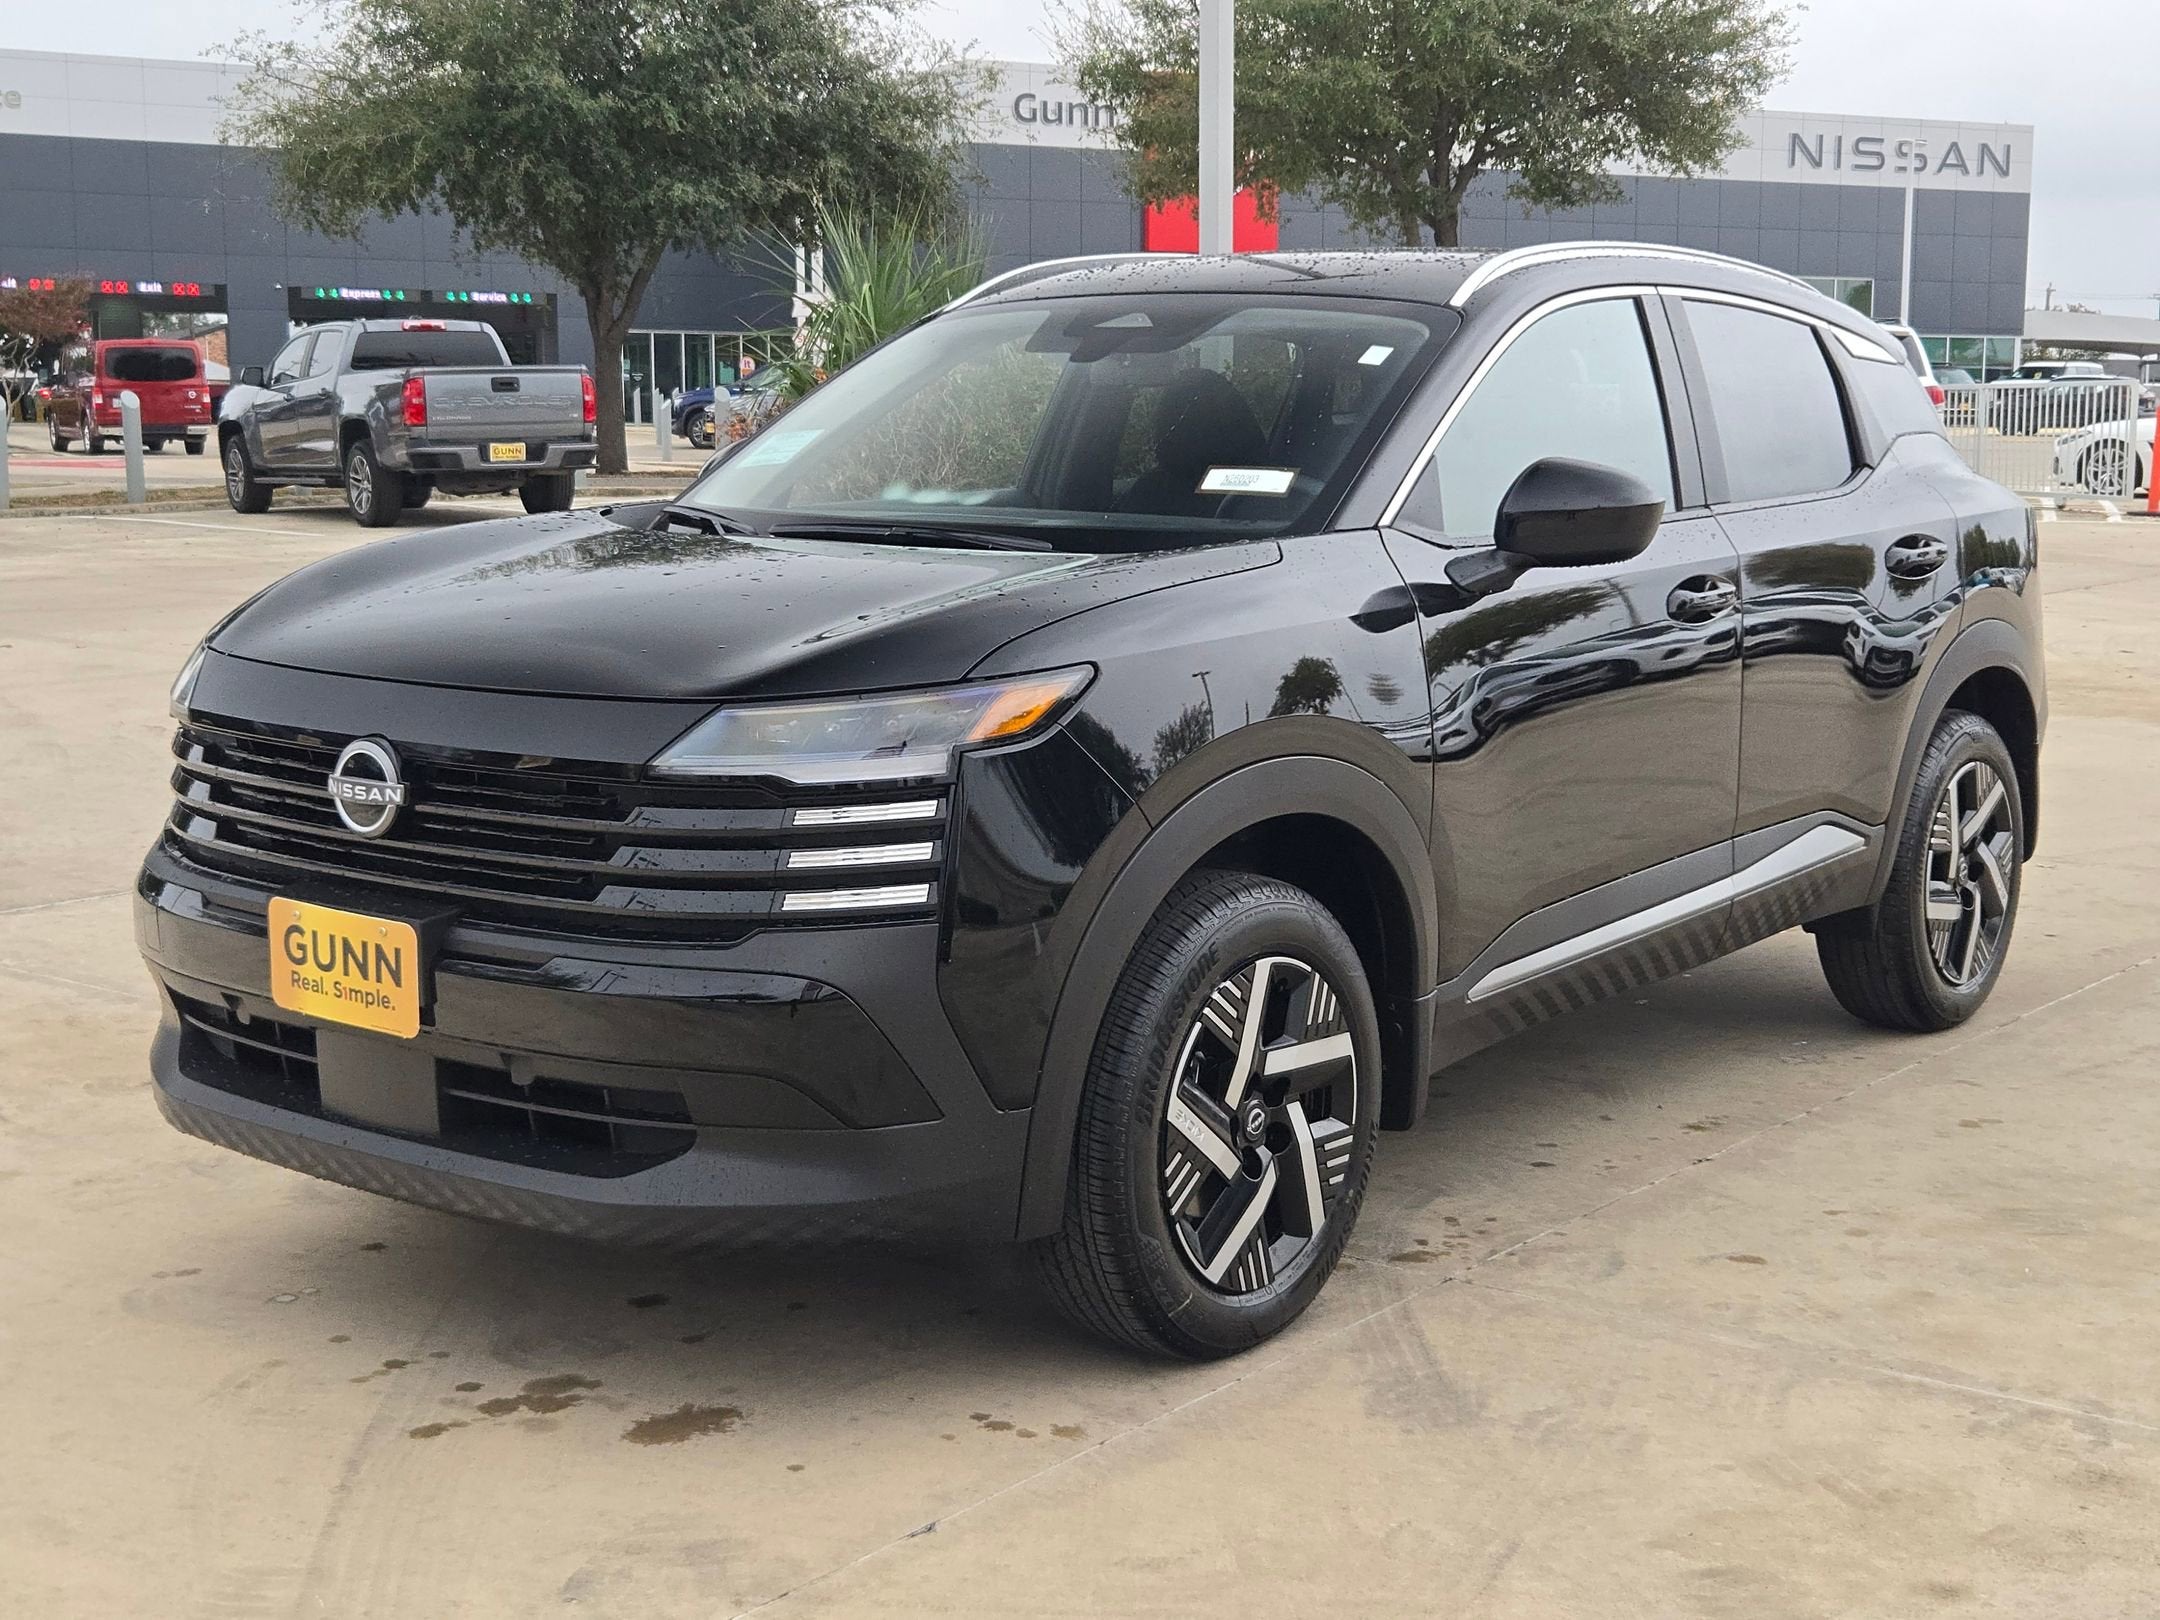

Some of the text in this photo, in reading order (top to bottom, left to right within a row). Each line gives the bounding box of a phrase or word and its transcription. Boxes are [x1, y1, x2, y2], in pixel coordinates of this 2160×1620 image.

[1013, 92, 1116, 128] Gunn
[1788, 132, 2012, 178] NISSAN
[493, 447, 522, 455] GUNN
[328, 778, 401, 803] NISSAN
[284, 924, 402, 988] GUNN
[291, 970, 396, 1012] Real. Simple.
